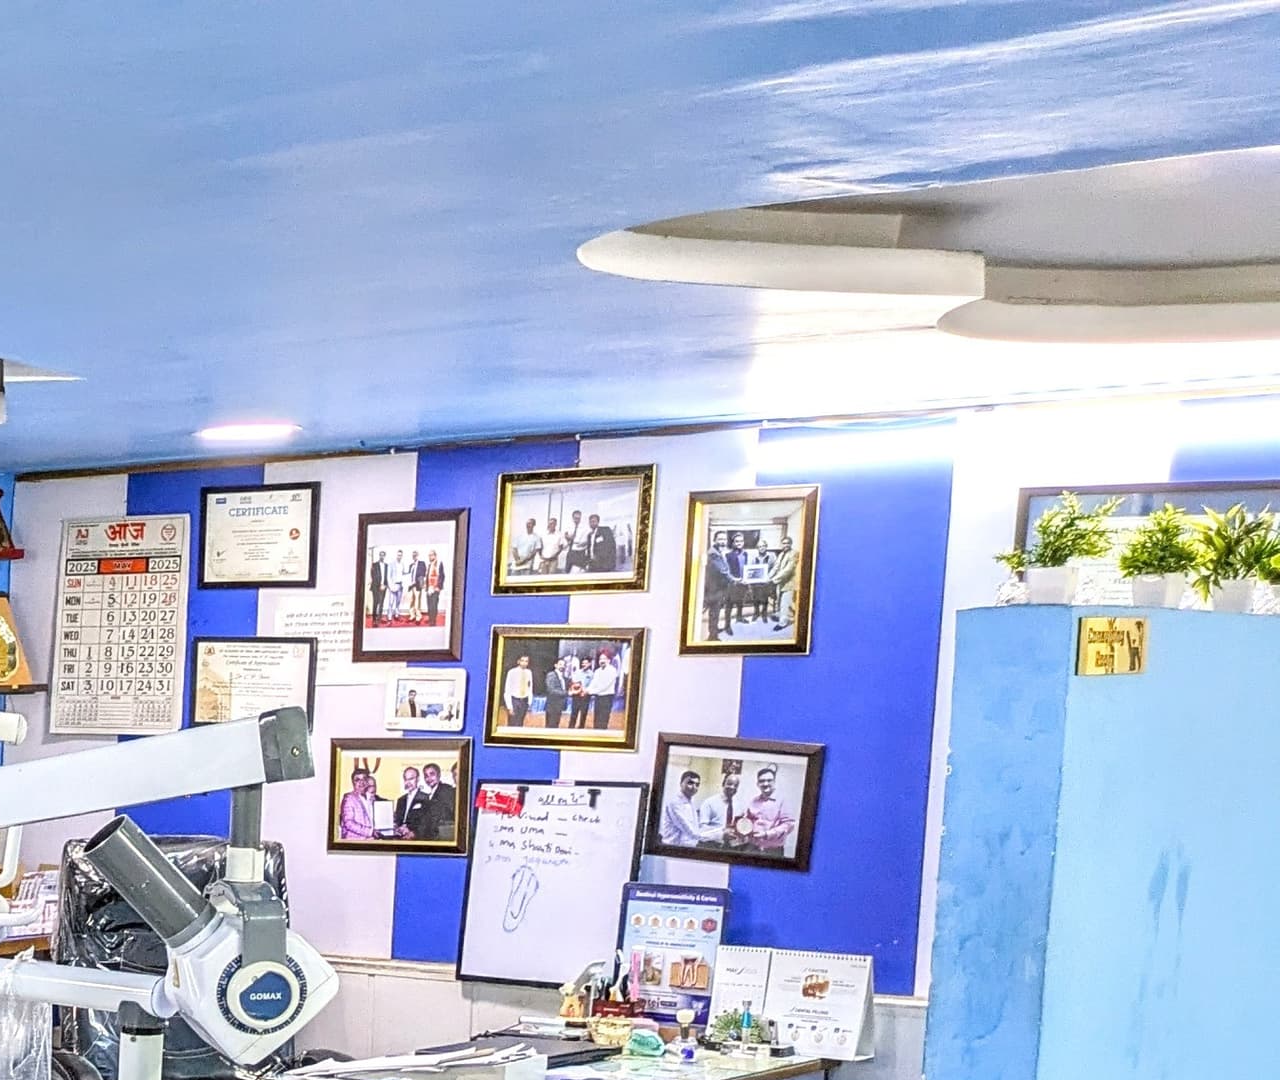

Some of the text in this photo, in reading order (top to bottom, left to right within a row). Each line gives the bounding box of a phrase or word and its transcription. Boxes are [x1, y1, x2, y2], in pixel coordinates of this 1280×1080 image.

[228, 505, 289, 517] CERTIFICATE
[104, 521, 146, 541] आज
[69, 562, 97, 572] 2025
[151, 559, 179, 570] 2025
[67, 578, 81, 588] SUN
[125, 576, 137, 586] 11
[144, 575, 158, 586] 18
[161, 574, 177, 585] 25
[65, 595, 81, 606] MON
[108, 594, 116, 605] 5
[124, 593, 137, 604] 12
[143, 593, 157, 604] 19
[66, 610, 176, 623] TUE 6 13 20 27
[64, 628, 175, 641] WED 7 14 21 28
[64, 646, 174, 658] THU 1 8 15 22 29
[63, 662, 173, 674] FRI 2 9 16 23 30
[61, 680, 171, 691] SAT 3 10 17 24 31
[250, 992, 282, 1000] GOMAX
